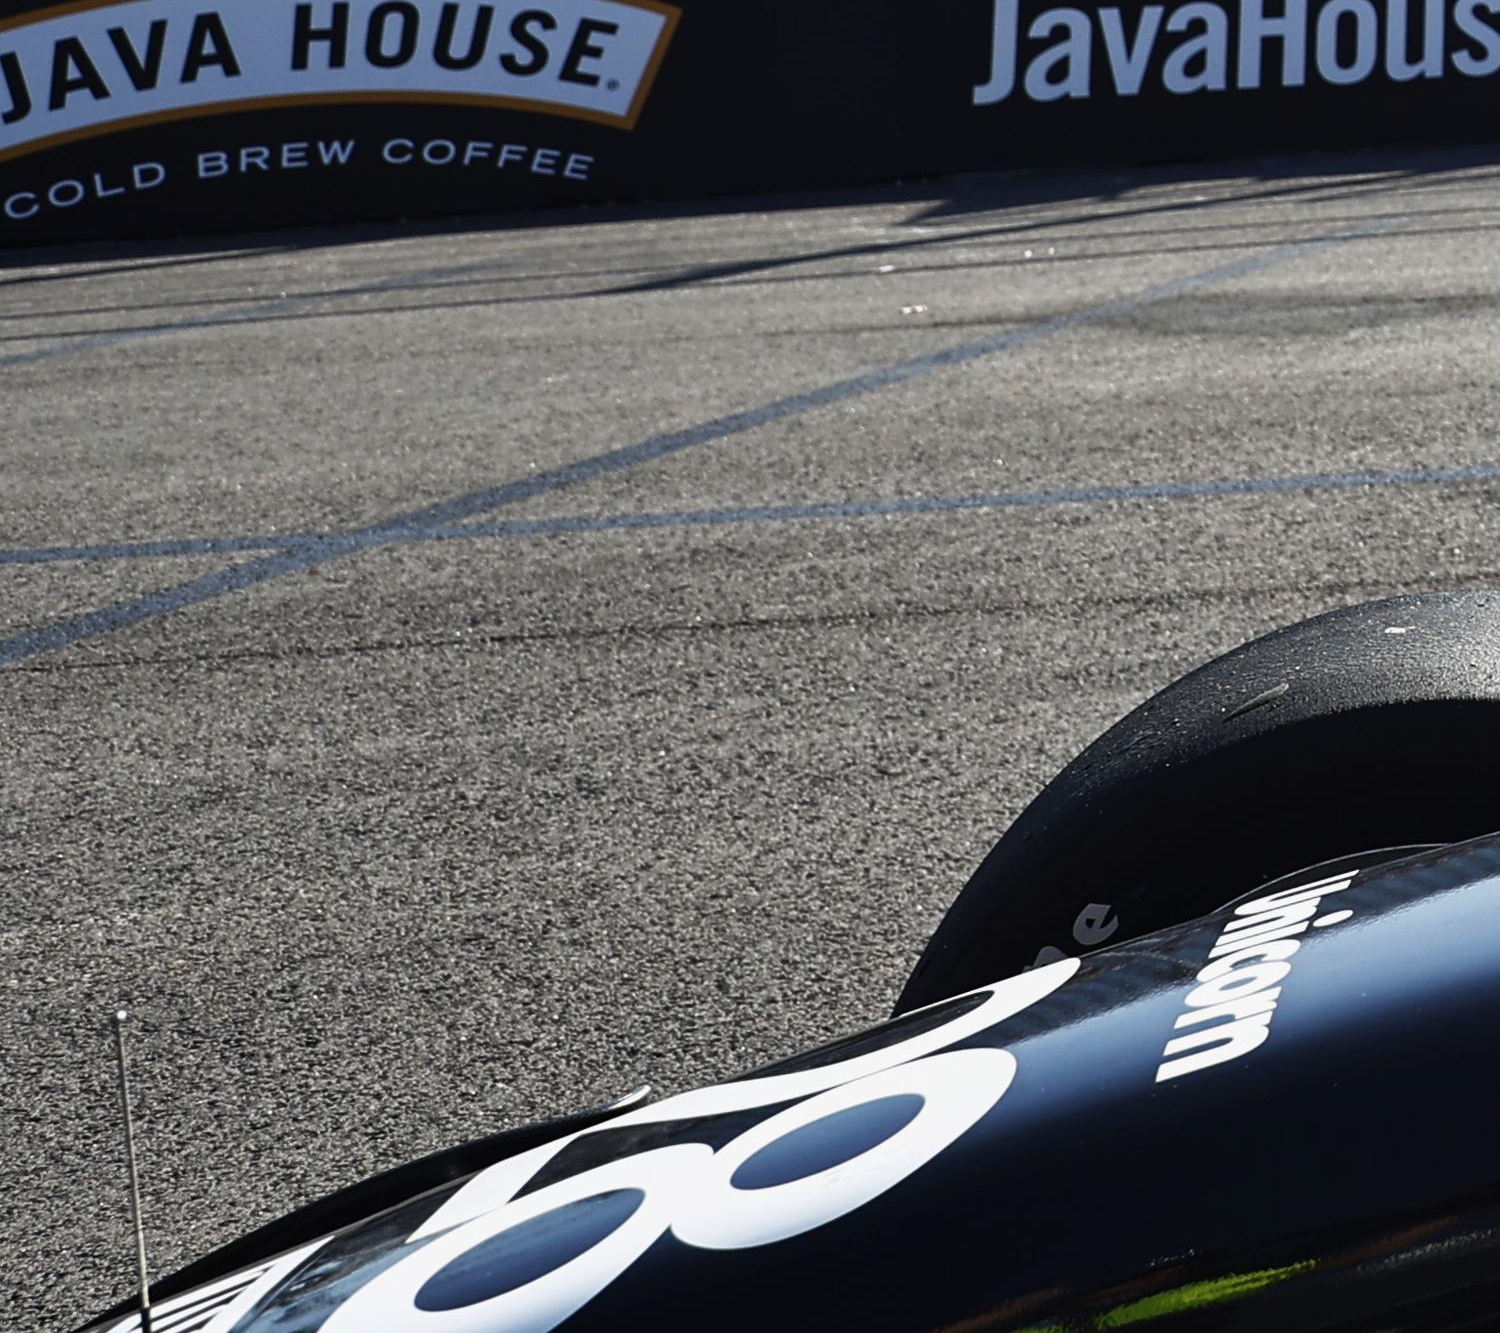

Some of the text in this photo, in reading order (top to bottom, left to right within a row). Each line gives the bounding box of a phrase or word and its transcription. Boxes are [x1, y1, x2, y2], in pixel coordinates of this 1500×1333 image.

[0, 11, 242, 125] JAVA
[3, 137, 595, 221] COLD BREW COFFEE
